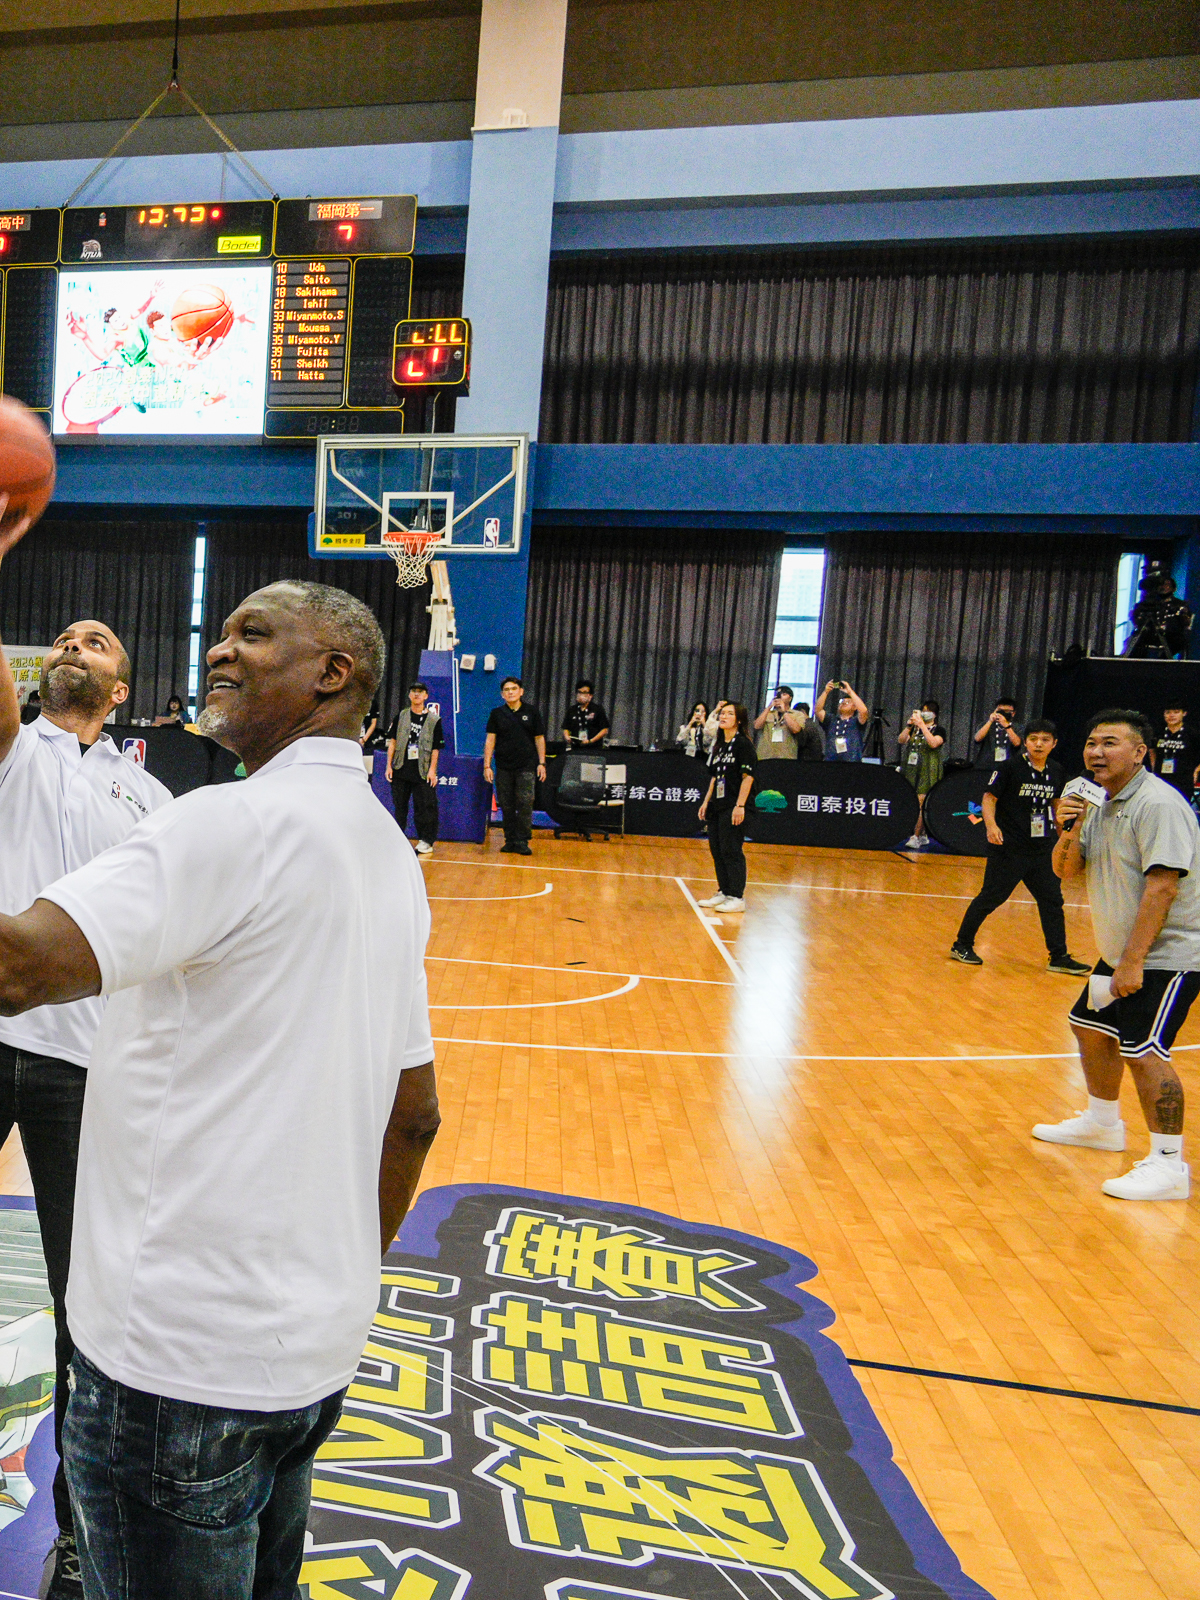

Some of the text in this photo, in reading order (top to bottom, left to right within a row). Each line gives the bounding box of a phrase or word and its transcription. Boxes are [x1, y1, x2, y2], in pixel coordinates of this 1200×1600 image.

[317, 202, 375, 219] 福岡第一
[338, 224, 353, 240] 7
[220, 239, 260, 251] Bodet
[276, 262, 326, 274] 10 Uda
[276, 275, 331, 286] 15 Saito
[275, 287, 287, 298] 18
[273, 299, 329, 310] 21 Ishii
[273, 311, 285, 322] 33
[272, 323, 285, 334] 34
[272, 335, 283, 346] 35
[271, 347, 329, 358] 39 Fujita
[270, 359, 281, 370] 51
[270, 370, 325, 381] 77 Hatta
[436, 775, 458, 786] 金控
[603, 785, 701, 803] 泰綜合證券
[797, 794, 891, 817] 國泰投信
[482, 1208, 892, 1600] 邀請賽
